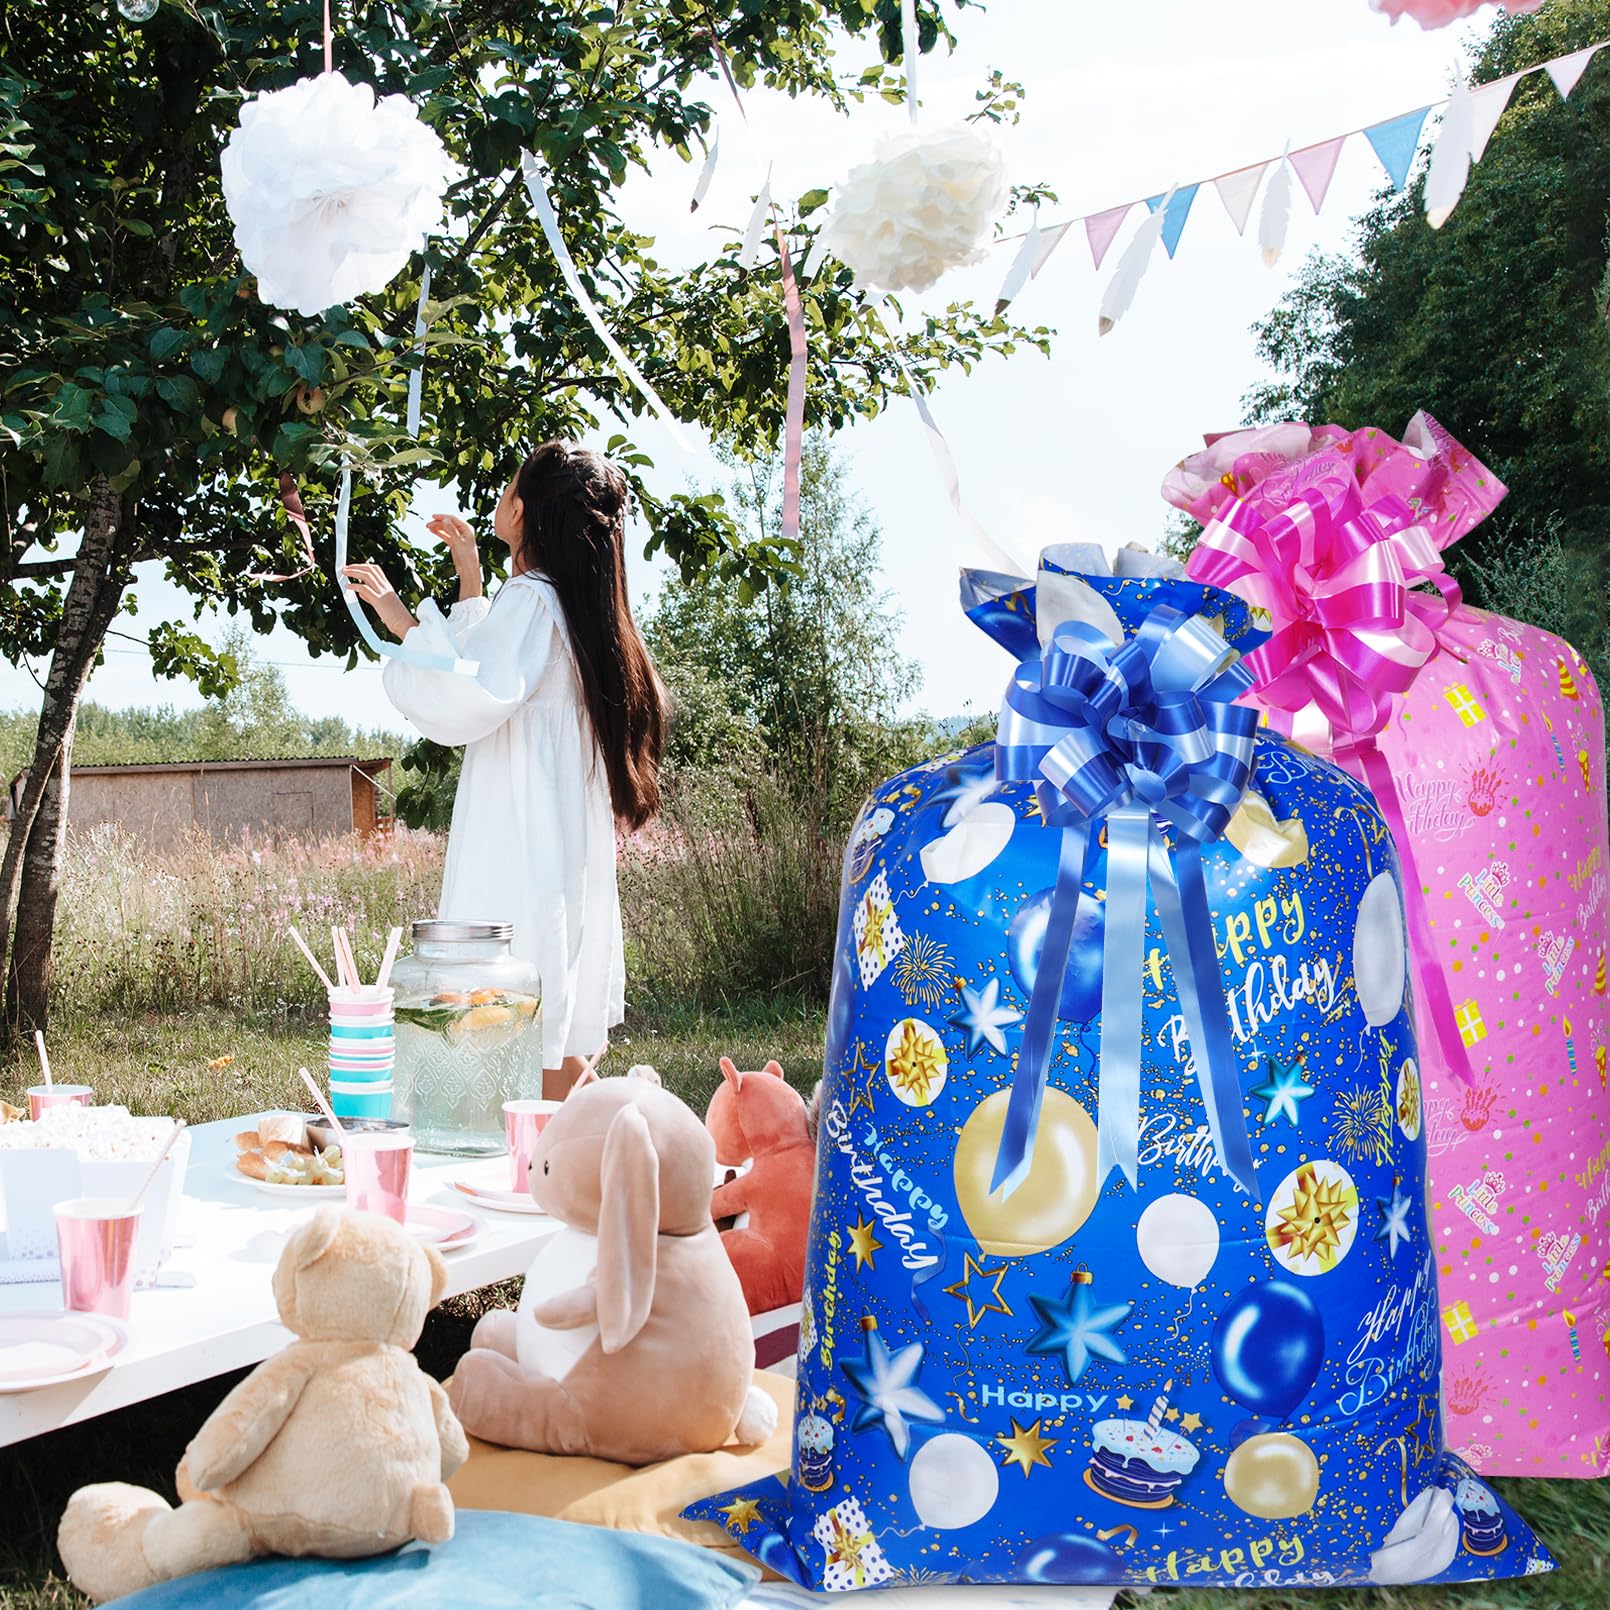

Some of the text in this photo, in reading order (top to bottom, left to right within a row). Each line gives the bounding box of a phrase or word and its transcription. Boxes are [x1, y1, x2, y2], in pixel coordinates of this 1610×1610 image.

[826, 1098, 939, 1270] Birthday
[863, 1121, 949, 1231] Happy
[819, 1230, 844, 1372] Birthday
[1338, 1286, 1439, 1416] Birthday
[1346, 1248, 1432, 1365] Happy
[981, 1383, 1110, 1413] Happy
[1145, 1532, 1305, 1583] Happy
